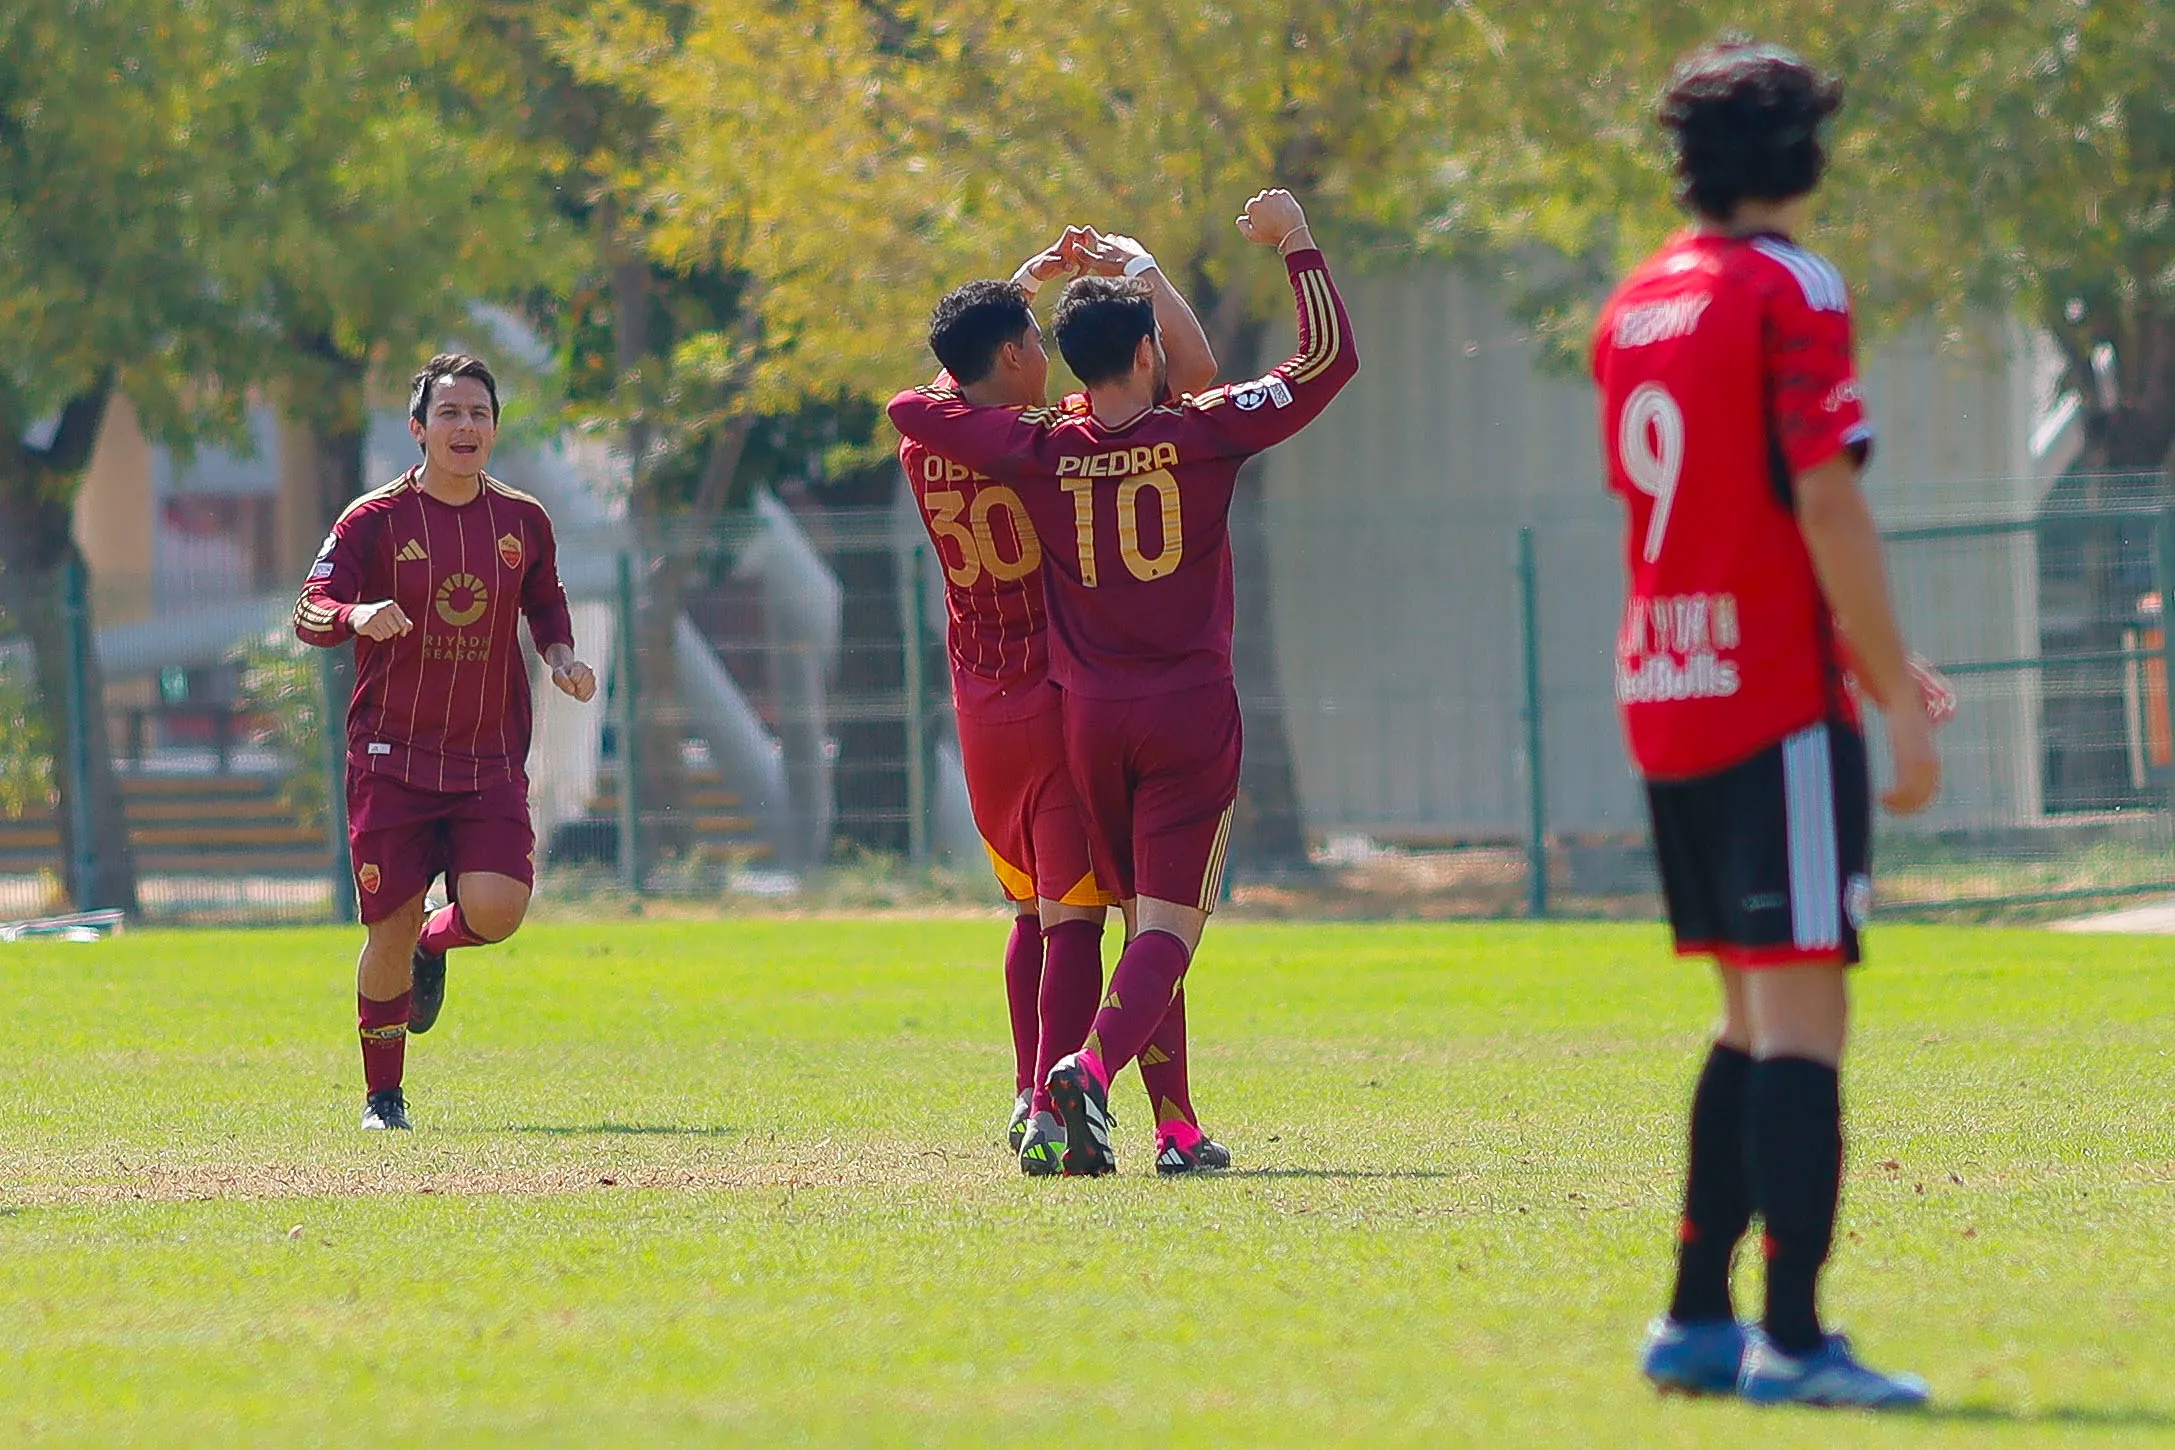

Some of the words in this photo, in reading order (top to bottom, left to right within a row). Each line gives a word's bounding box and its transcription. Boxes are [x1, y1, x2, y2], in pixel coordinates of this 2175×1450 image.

[923, 455, 992, 482] OB
[1056, 442, 1179, 477] PIEDRA
[1618, 380, 1686, 565] 9
[924, 486, 1042, 588] 30
[1060, 468, 1183, 588] 10
[422, 649, 490, 662] SEASON
[423, 634, 491, 648] RIYADH
